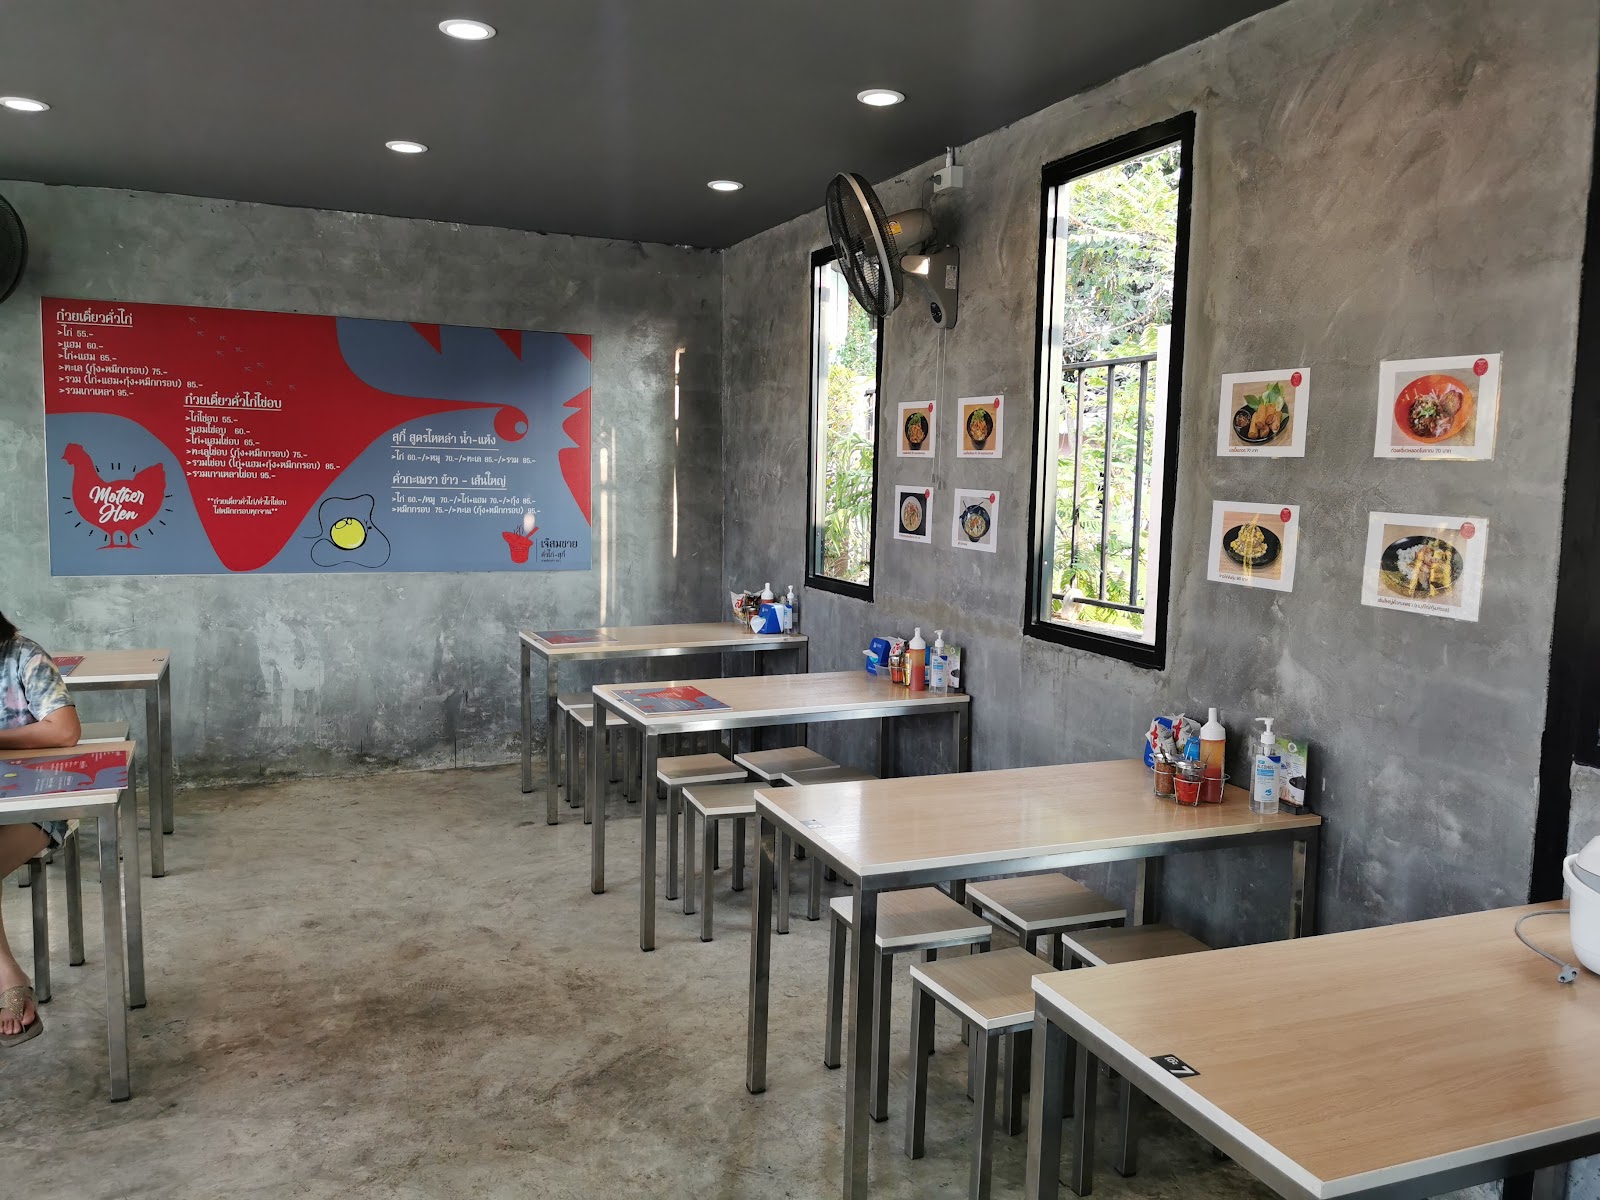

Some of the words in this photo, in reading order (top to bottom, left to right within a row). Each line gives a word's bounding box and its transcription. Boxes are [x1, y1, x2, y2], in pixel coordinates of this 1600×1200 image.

[56, 308, 133, 325] ก๋วยเตี๋ยวคั่วไก่
[392, 428, 406, 445] สุกี้
[441, 473, 459, 485] ข้าว
[471, 471, 506, 488] เส้นใหญ่
[89, 486, 145, 505] Mother
[99, 503, 139, 524] Hen
[1170, 1065, 1195, 1074] 7
